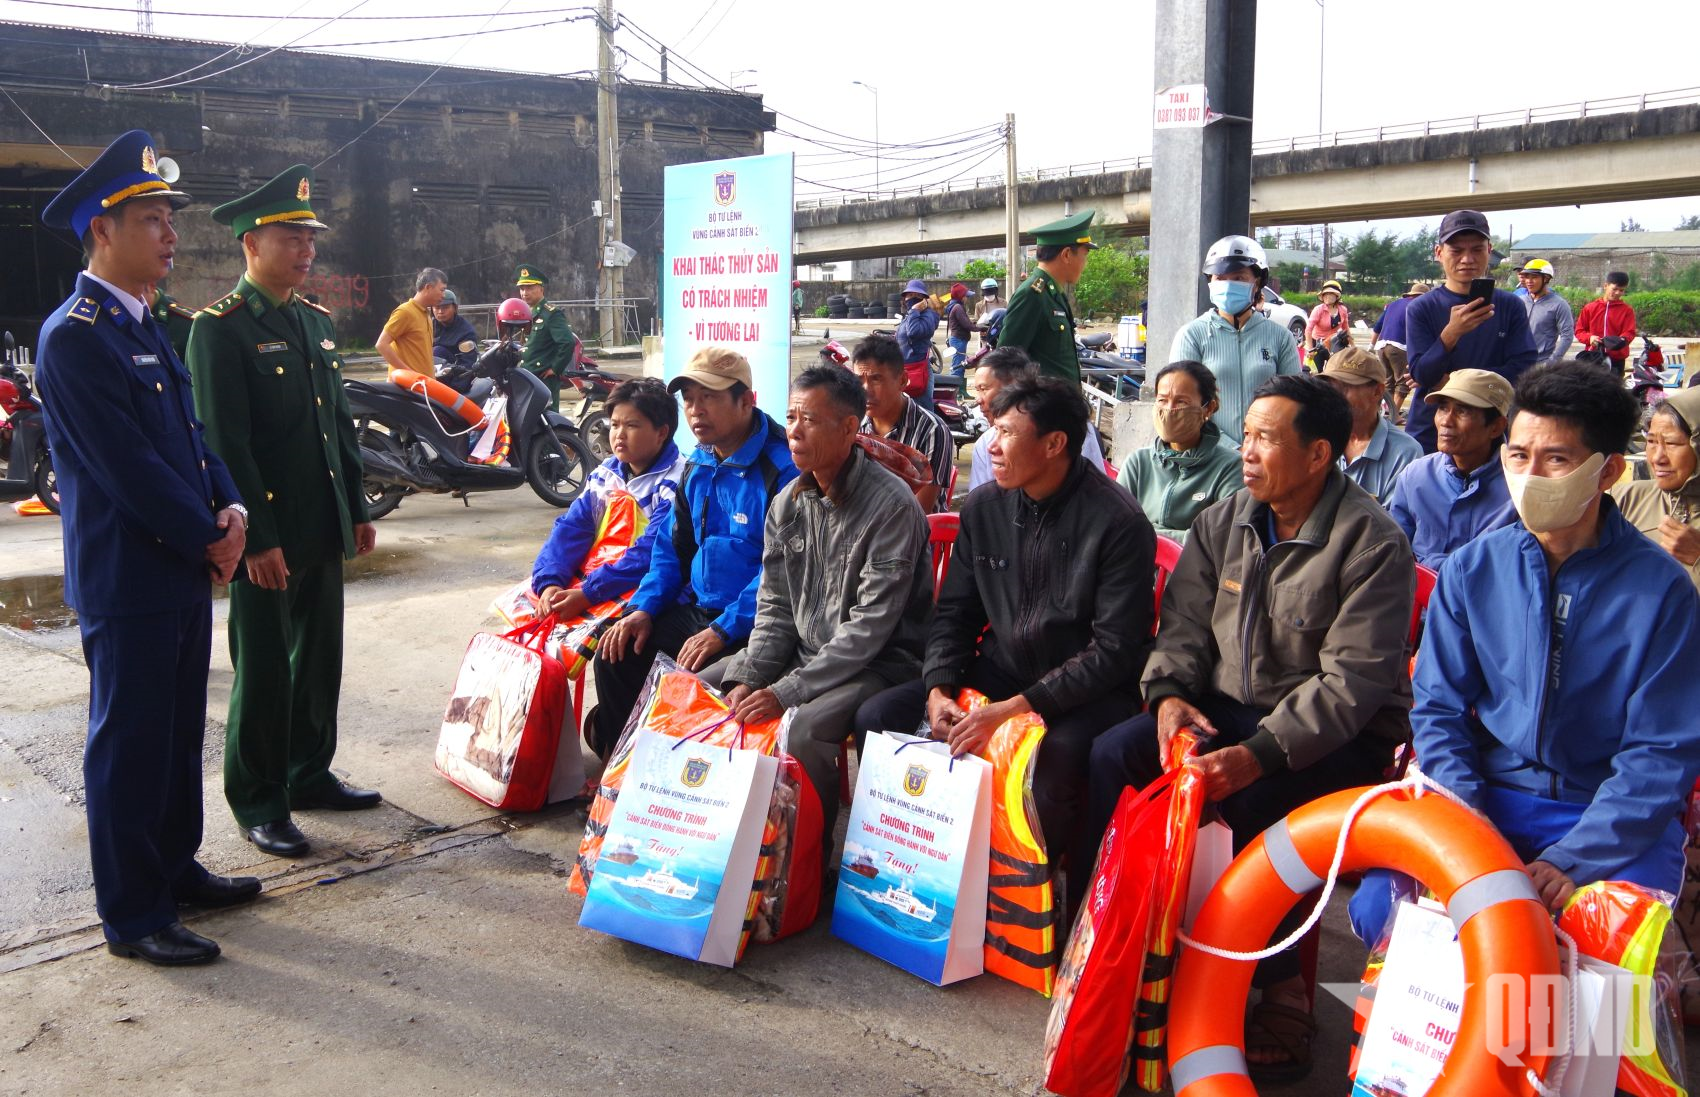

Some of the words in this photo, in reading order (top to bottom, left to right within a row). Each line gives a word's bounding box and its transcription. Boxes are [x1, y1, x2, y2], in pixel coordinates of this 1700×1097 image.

[1169, 93, 1189, 104] TAXI
[726, 210, 742, 223] LỆNH
[673, 257, 697, 276] KHAI
[699, 252, 725, 275] THÁC
[728, 248, 753, 274] THỦY
[757, 247, 779, 273] SẢN
[682, 286, 696, 308] CÓ
[698, 285, 731, 308] TRÁCH
[733, 284, 768, 312] NHIỆM
[695, 319, 705, 341] VÌ
[708, 321, 741, 341] TƯƠNG
[743, 322, 760, 341] LAI
[647, 804, 683, 821] CHƯƠNG
[684, 812, 708, 826] TRÌNH
[880, 813, 911, 833] CHƯƠNG
[912, 825, 935, 843] TRÌNH
[1408, 984, 1421, 998] BỘ
[1423, 990, 1436, 1003] TƯ
[1435, 996, 1460, 1014] LỆNH
[1425, 1022, 1456, 1046] CHƯ
[1414, 1041, 1431, 1056] SÁT
